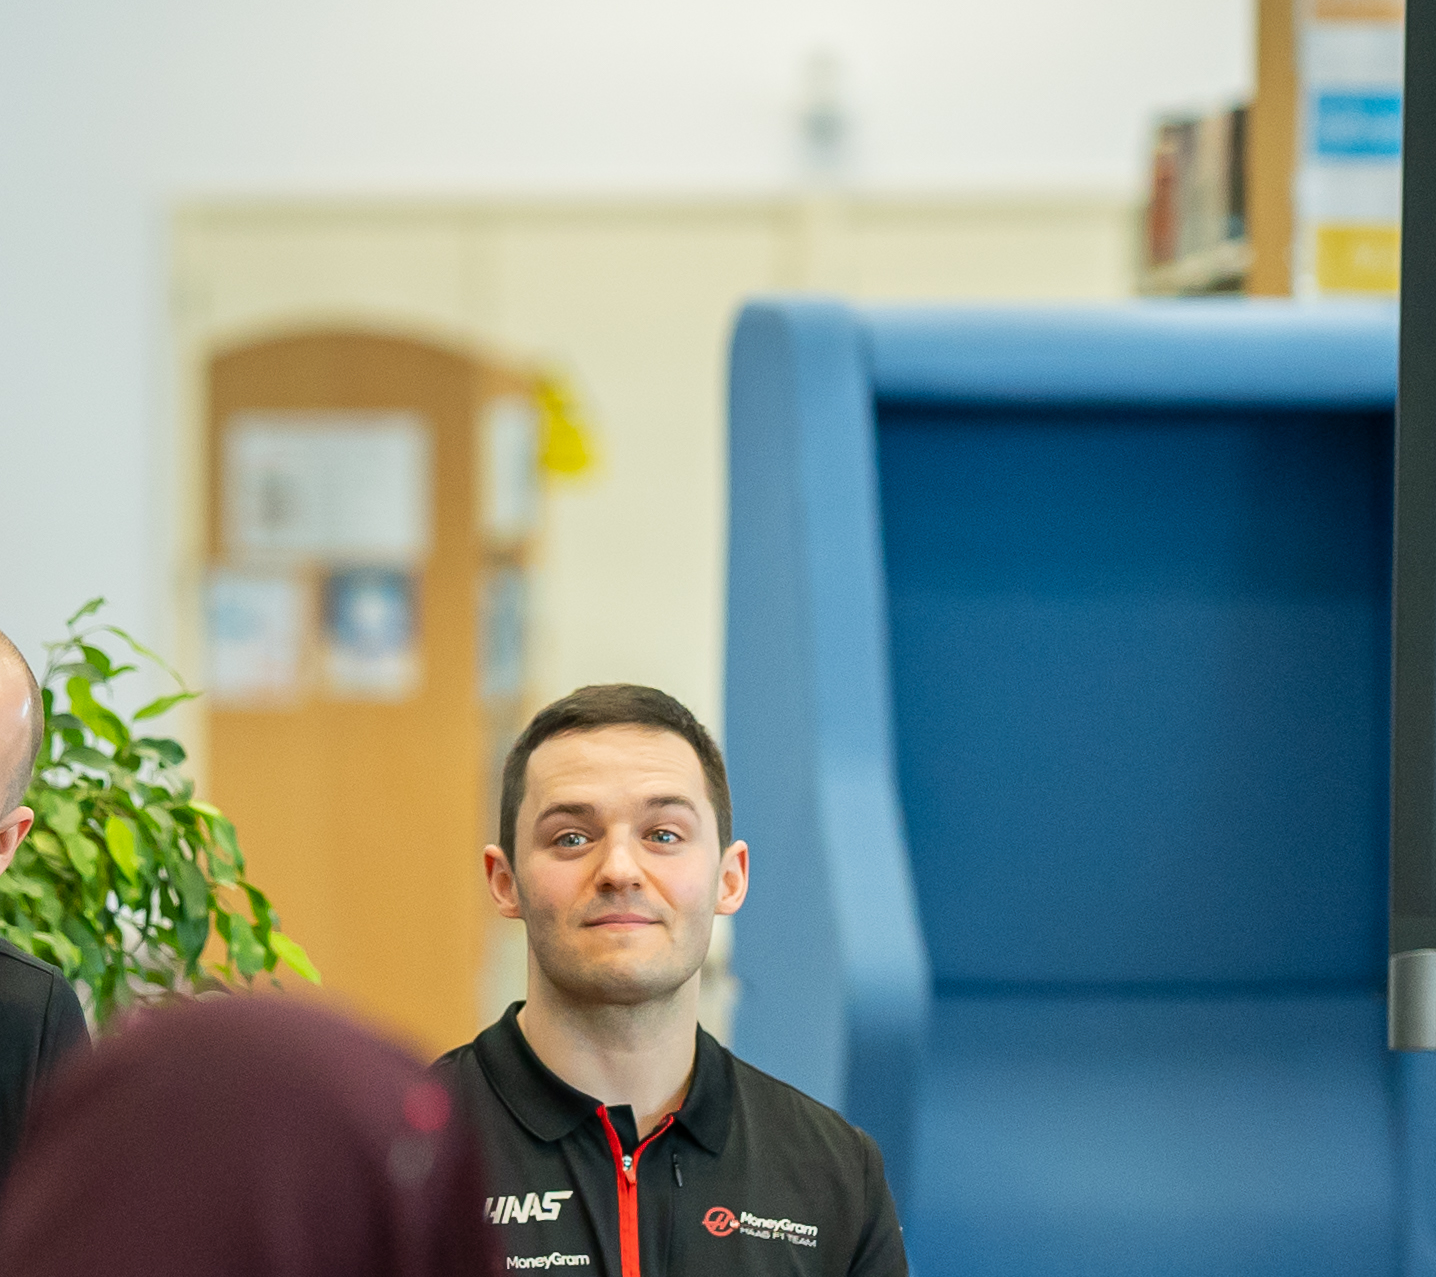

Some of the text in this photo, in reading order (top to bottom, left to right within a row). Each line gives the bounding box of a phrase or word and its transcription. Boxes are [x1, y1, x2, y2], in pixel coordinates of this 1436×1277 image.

[483, 1189, 574, 1225] HAAS
[740, 1211, 819, 1237] MoneyGram
[506, 1251, 591, 1270] MoneyGram
